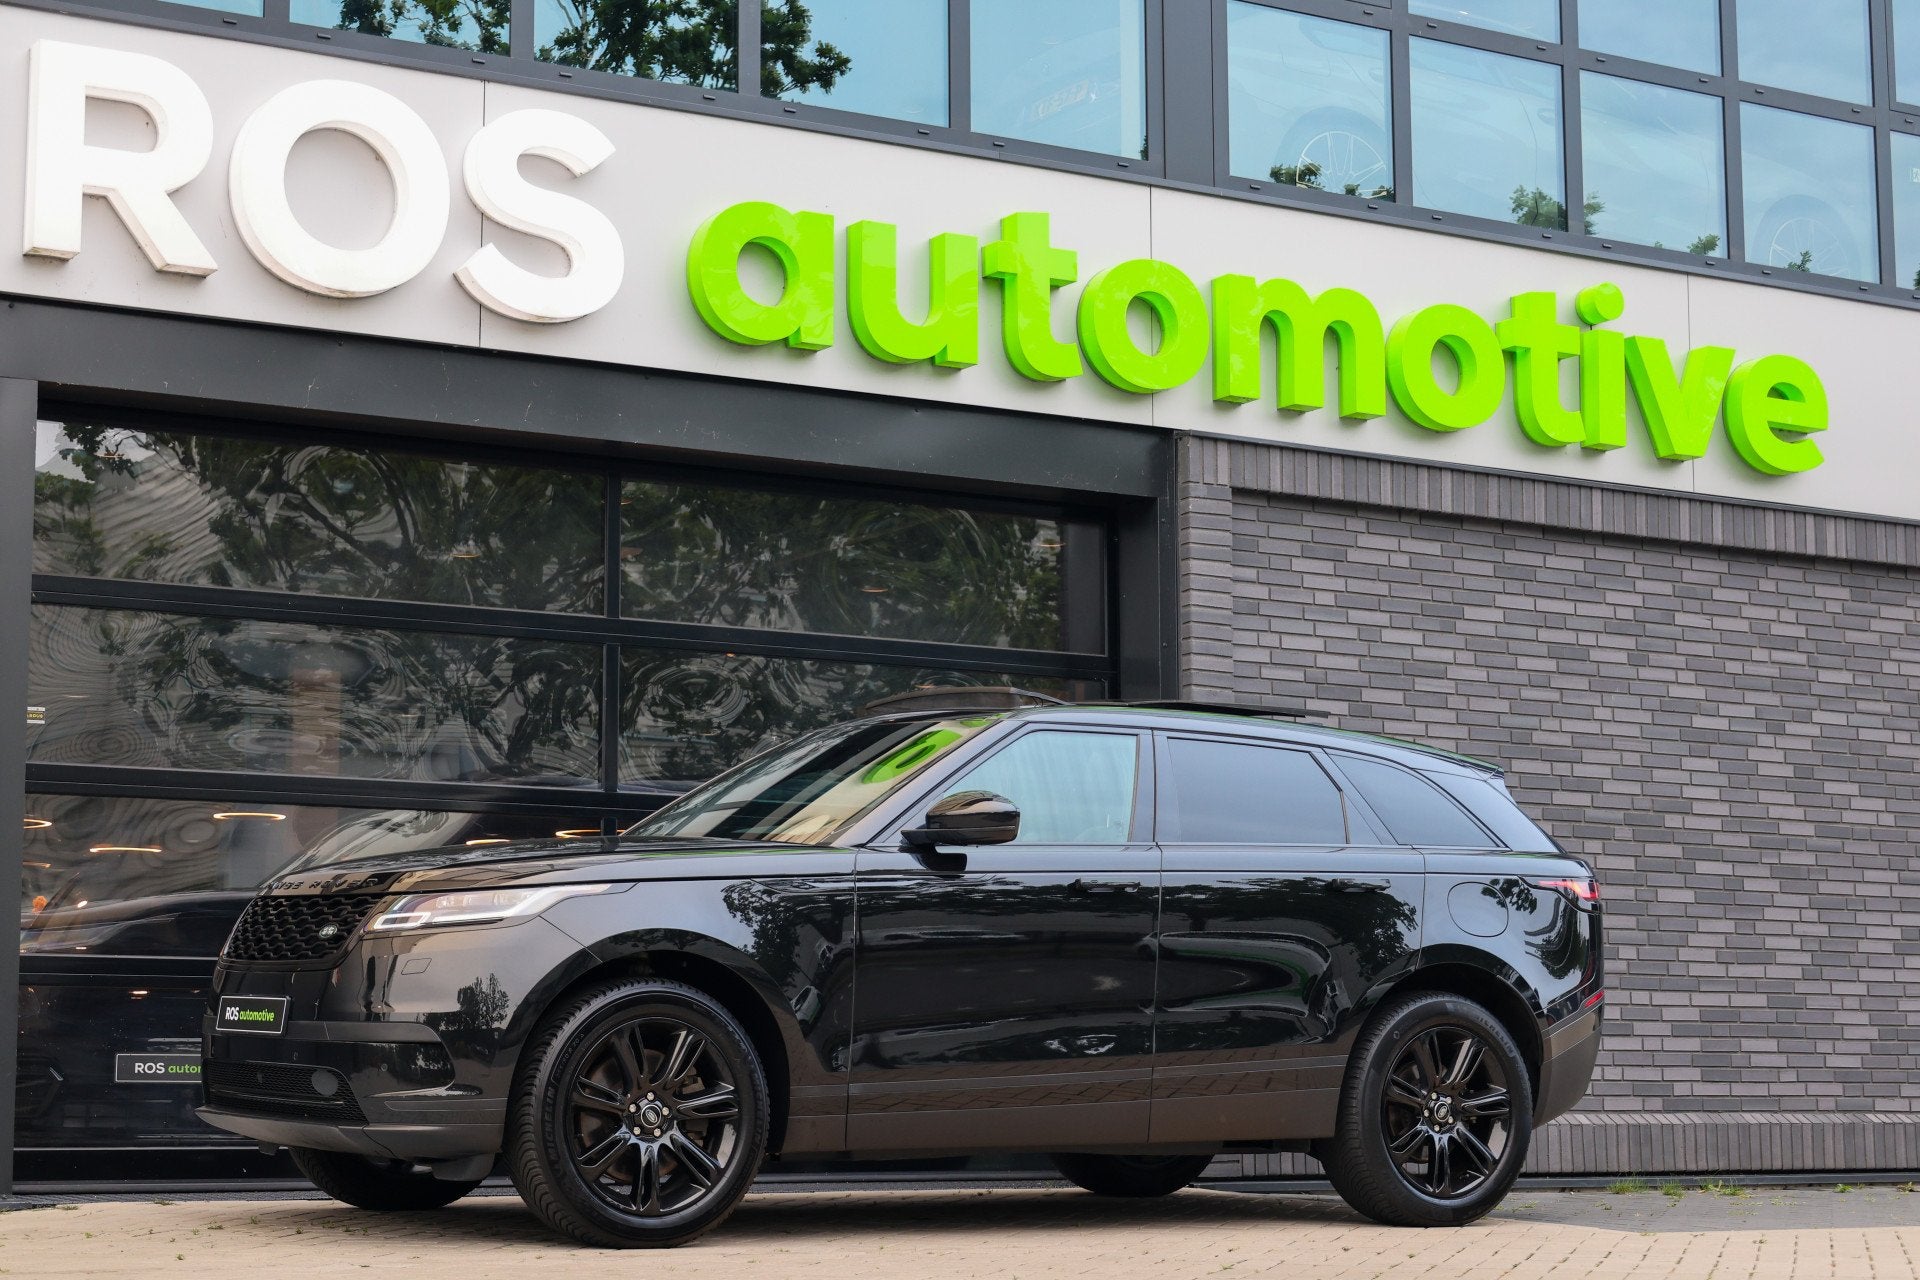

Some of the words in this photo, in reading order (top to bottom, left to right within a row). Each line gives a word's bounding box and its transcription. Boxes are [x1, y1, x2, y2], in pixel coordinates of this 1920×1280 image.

[23, 38, 625, 324] ROS
[686, 201, 1829, 476] automotive
[225, 1006, 240, 1021] ROS
[240, 1008, 274, 1021] automotive
[134, 1062, 166, 1074] ROS
[168, 1063, 202, 1074] auto
